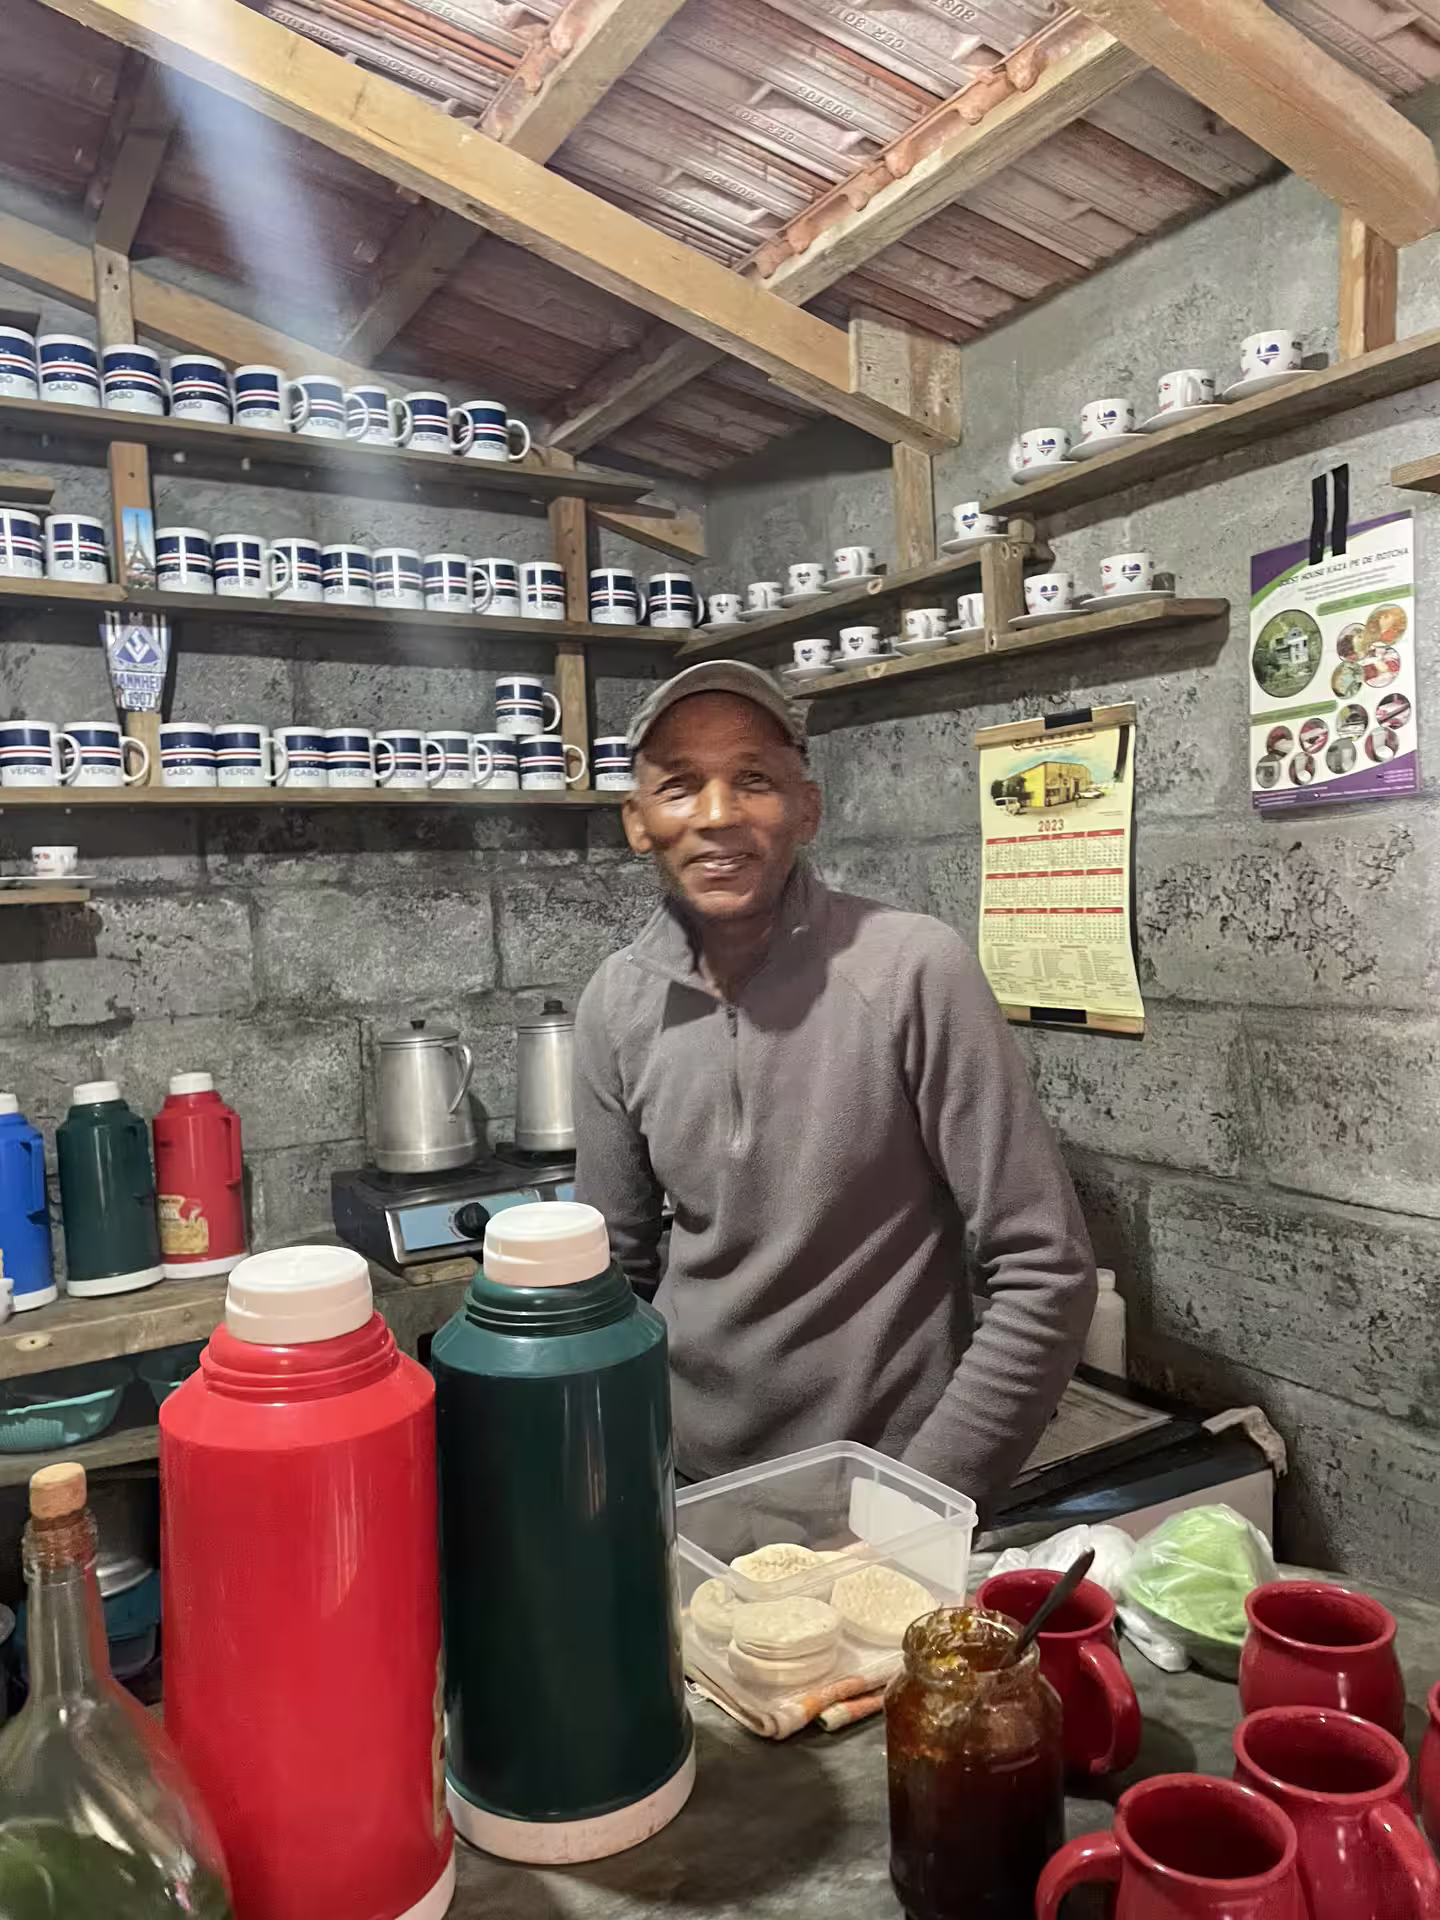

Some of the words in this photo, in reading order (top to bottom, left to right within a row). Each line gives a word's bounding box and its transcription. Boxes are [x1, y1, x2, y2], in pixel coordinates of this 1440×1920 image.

[797, 85, 854, 119] BUSTOS
[48, 382, 79, 392] CABO
[175, 401, 202, 410] CABO
[242, 409, 275, 418] VERDE
[310, 419, 341, 429] VERDE
[414, 433, 444, 443] VERDE
[477, 441, 506, 451] VERDE
[63, 561, 93, 571] CABO
[1301, 566, 1326, 582] HOUSE
[1326, 563, 1348, 575] KAZA
[1349, 557, 1362, 569] PE
[1362, 554, 1375, 566] DE
[127, 691, 153, 707] 1907
[9, 766, 48, 776] VERDE
[84, 766, 117, 776] VERDE
[167, 767, 193, 777] CABO
[224, 767, 256, 777] VERDE
[294, 768, 320, 778] CABO
[336, 769, 367, 778] VERDE
[1038, 819, 1065, 833] 2023
